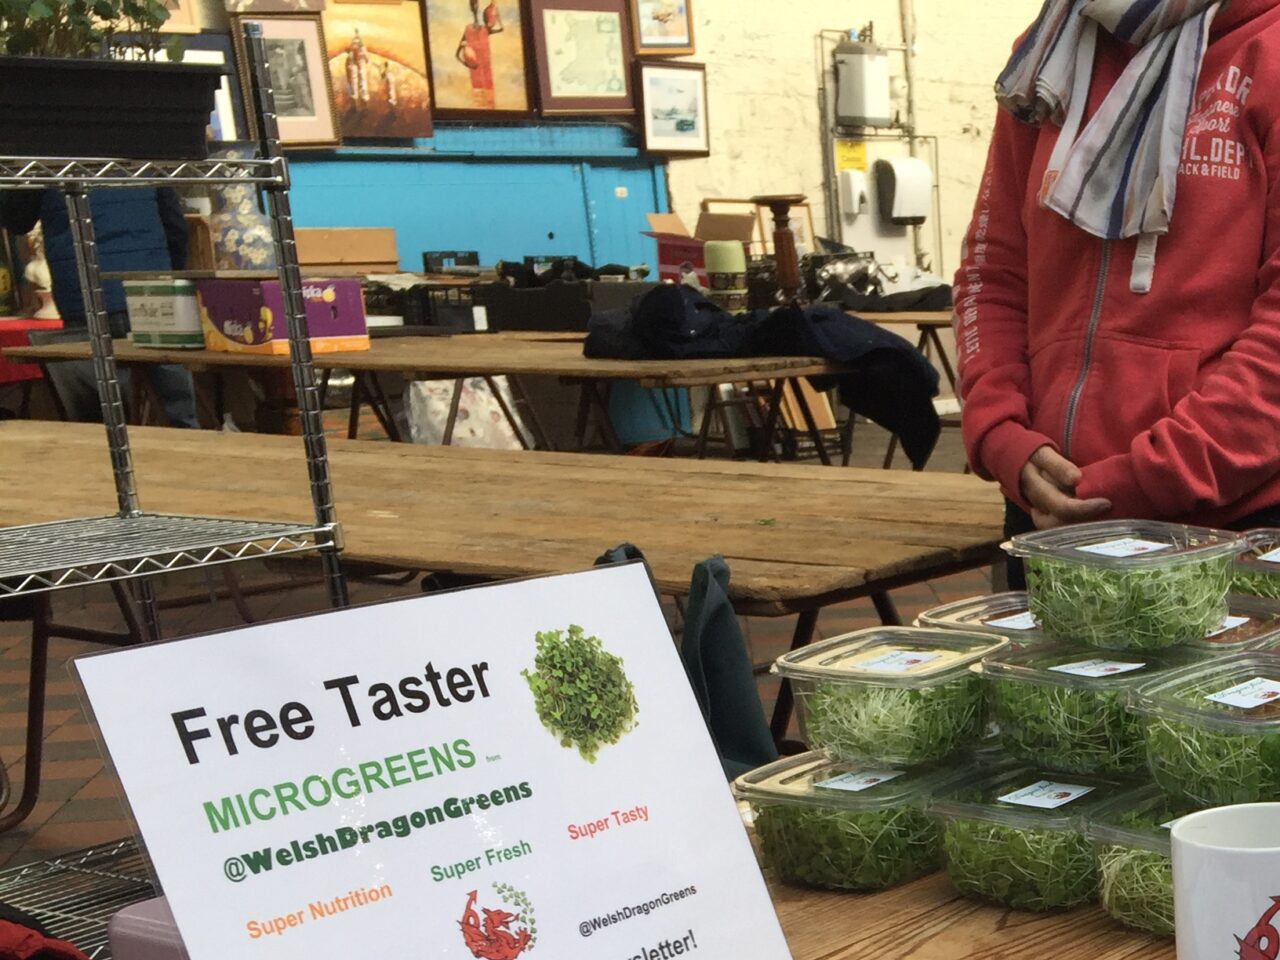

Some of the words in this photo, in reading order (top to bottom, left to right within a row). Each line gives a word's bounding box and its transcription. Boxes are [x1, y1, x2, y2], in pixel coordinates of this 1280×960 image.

[1210, 164, 1241, 180] FIELD
[171, 701, 315, 764] Free
[323, 661, 491, 727] Taster
[203, 738, 477, 833] MICROGREENS
[223, 781, 533, 883] @WelshDragonGreens
[567, 815, 610, 840] Super
[610, 803, 650, 828] Tasty
[430, 855, 482, 882] Super
[484, 839, 532, 866] Fresh
[246, 909, 304, 939] Super
[308, 883, 393, 920] Nutrition
[579, 883, 697, 938] @WelshDragonGreens
